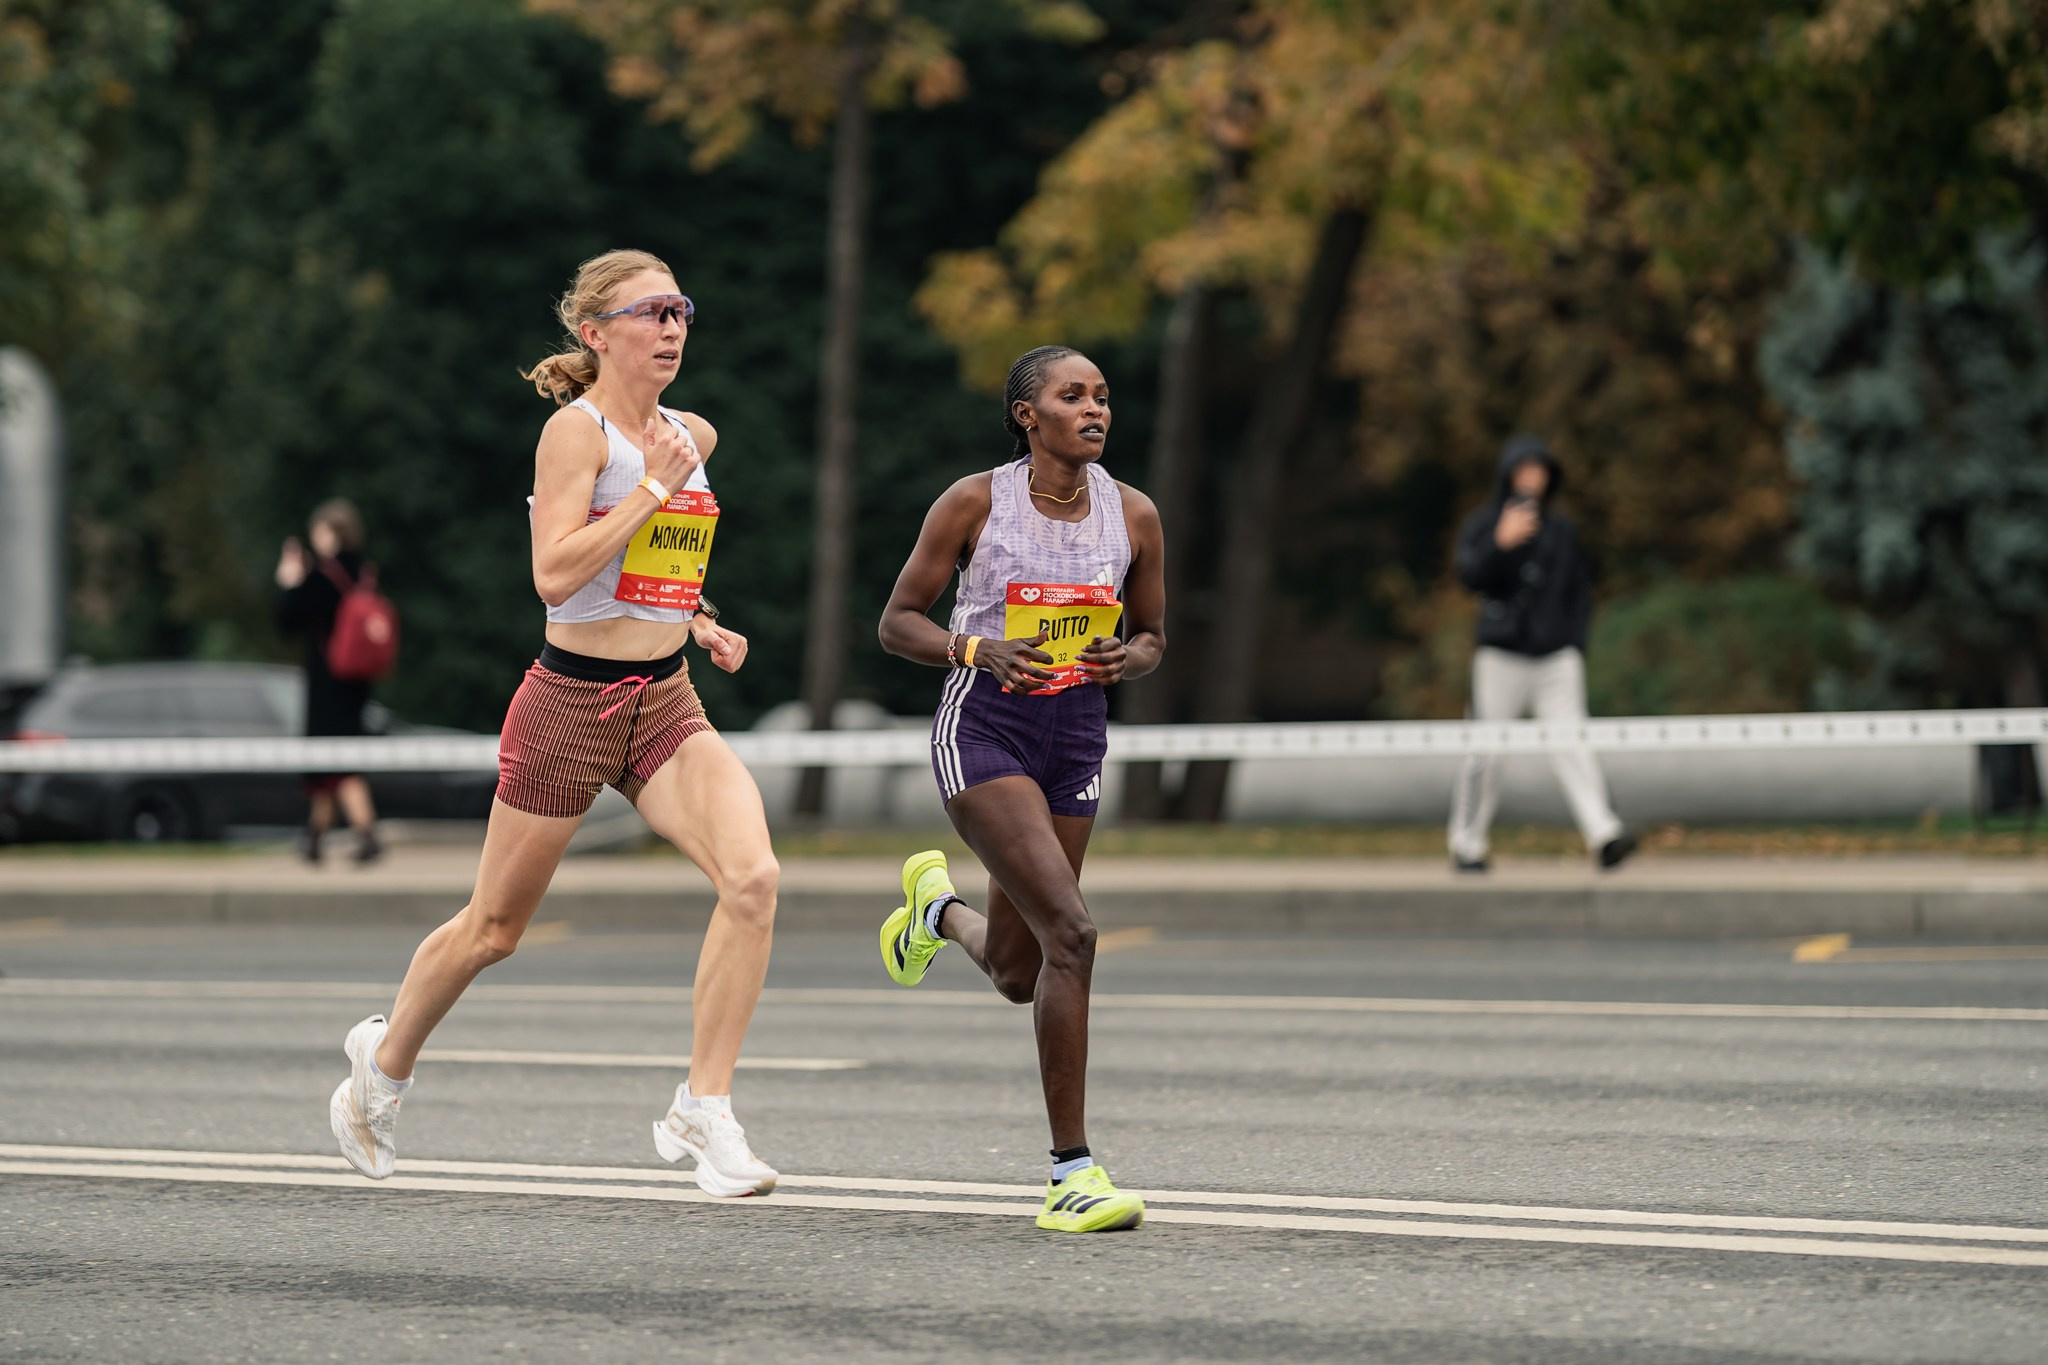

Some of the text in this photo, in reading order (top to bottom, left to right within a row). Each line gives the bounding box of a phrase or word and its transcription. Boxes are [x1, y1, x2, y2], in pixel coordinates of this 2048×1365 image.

[649, 525, 708, 553] МОКИНА
[670, 565, 680, 574] 33
[1039, 615, 1090, 642] RUTTO
[1058, 652, 1068, 662] 32
